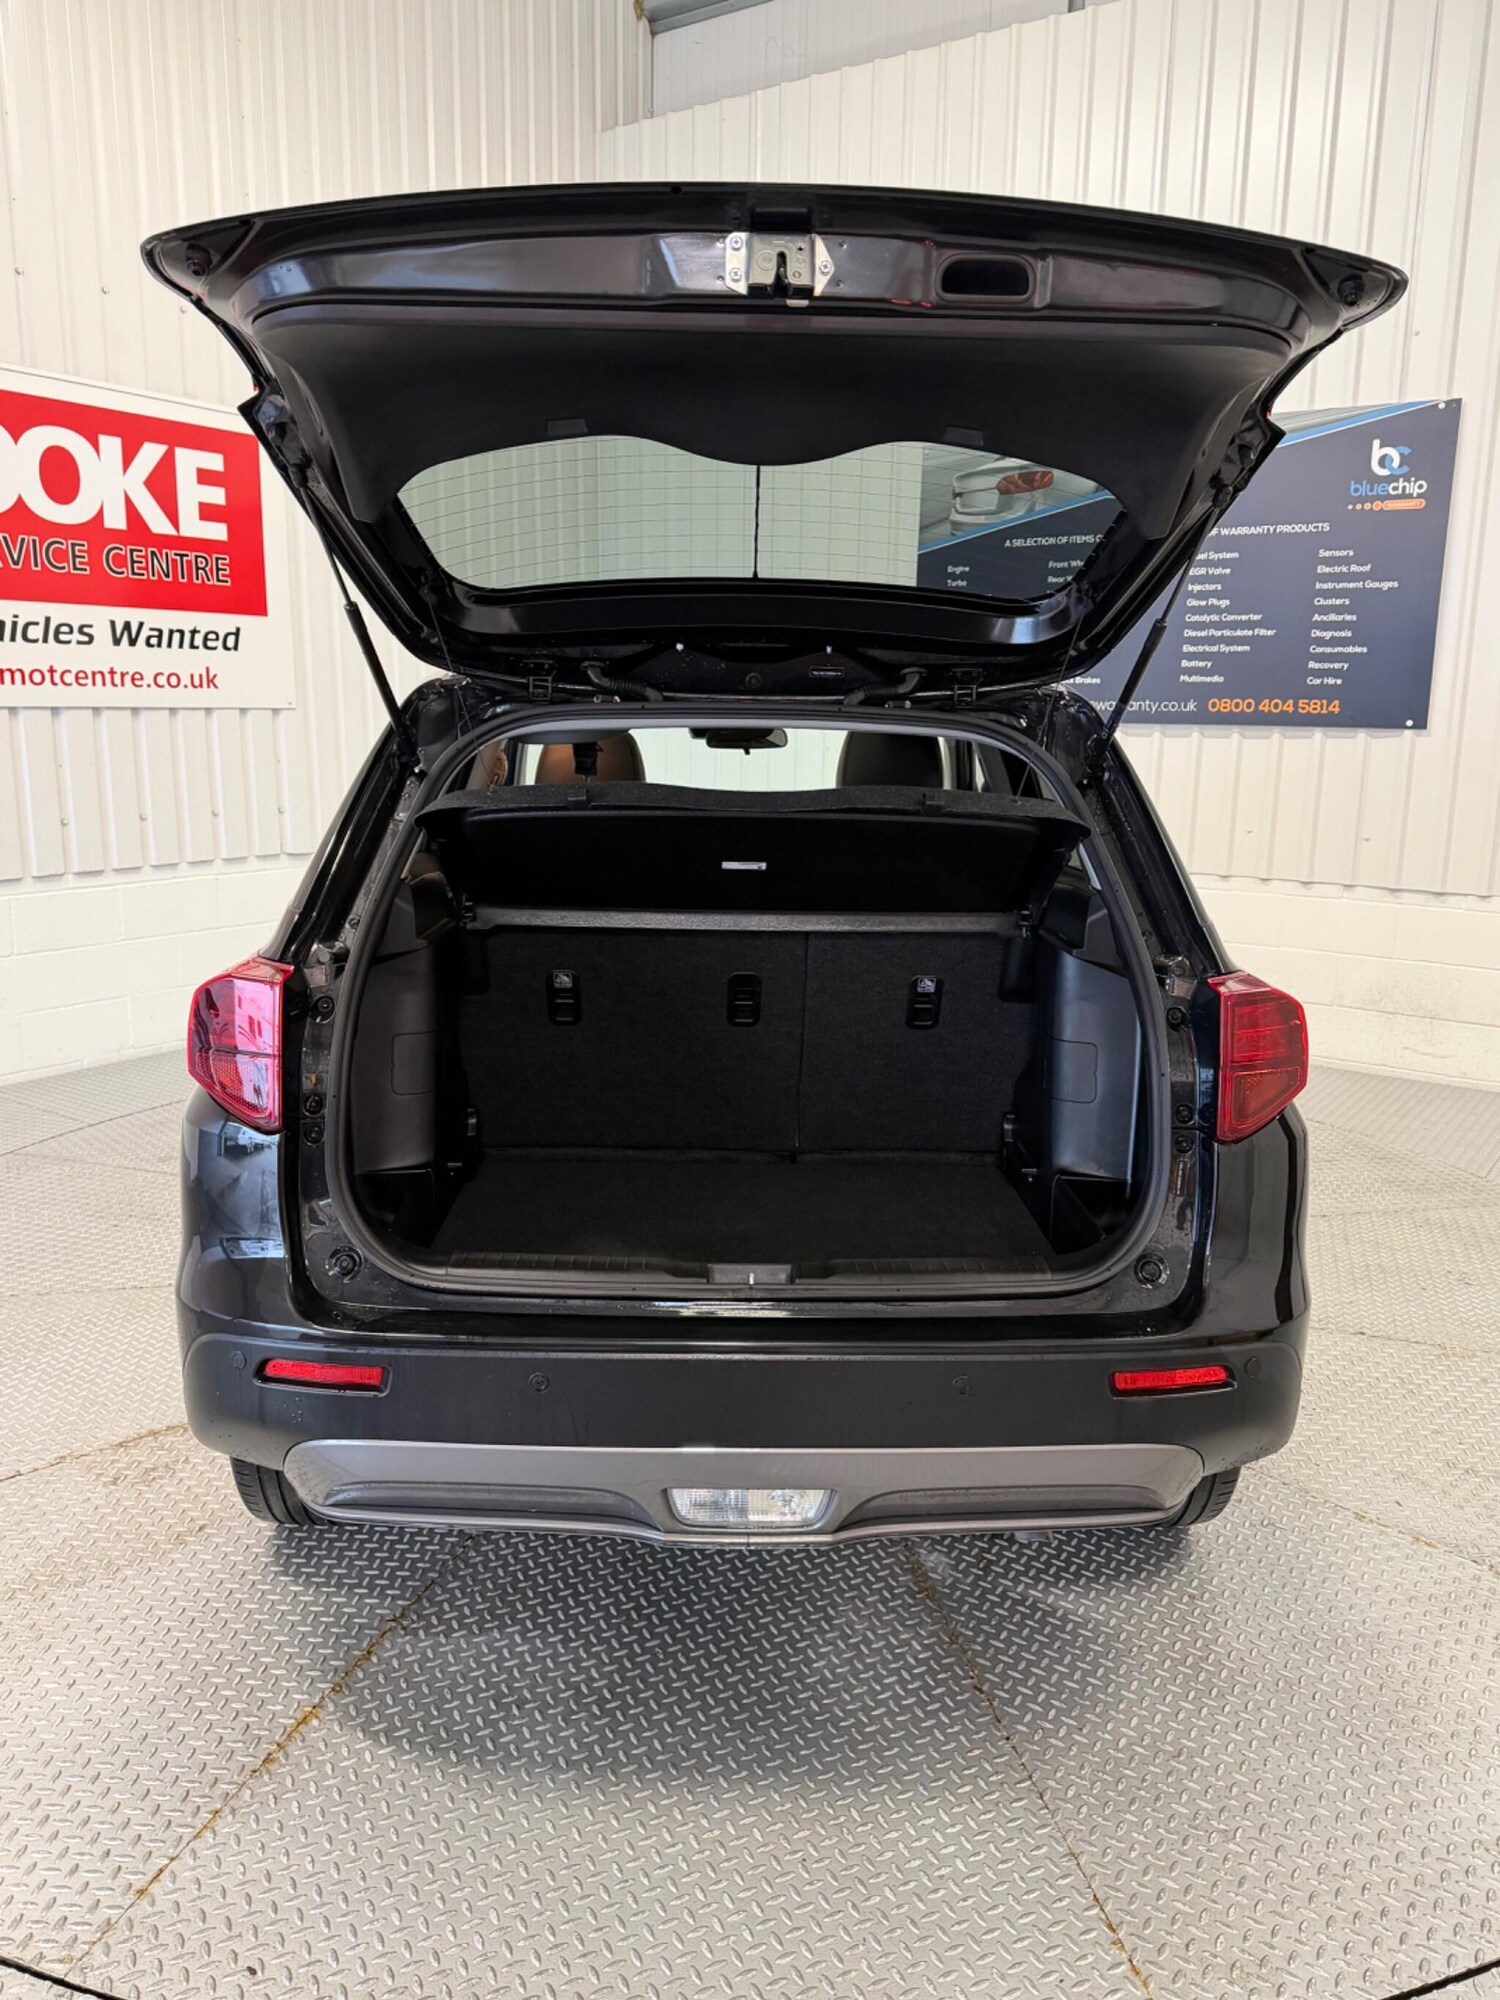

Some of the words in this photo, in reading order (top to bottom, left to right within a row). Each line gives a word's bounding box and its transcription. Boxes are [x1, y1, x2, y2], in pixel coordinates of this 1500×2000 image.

[0, 425, 228, 541] OKE
[1349, 477, 1428, 497] bluechip
[1220, 525, 1276, 536] WARRANTY
[1276, 522, 1330, 534] PRODUCTS
[1004, 539, 1012, 548] A
[1012, 536, 1057, 548] SELECTION
[1057, 535, 1069, 545] OF
[1069, 534, 1095, 544] ITEMS
[1208, 551, 1240, 561] System
[1318, 548, 1354, 557] Sensors
[0, 533, 90, 574] VICE
[102, 544, 231, 587] CENTRE
[1048, 560, 1068, 569] Front
[947, 565, 970, 575] Engine
[1189, 566, 1207, 576] EGR
[1207, 566, 1232, 576] Valve
[1317, 564, 1349, 574] Electric
[1349, 563, 1372, 573] Roof
[947, 579, 968, 588] Turbo
[1188, 582, 1222, 594] Injectors
[1315, 581, 1364, 590] Instrument
[1364, 579, 1399, 591] Gauges
[1186, 598, 1207, 607] Glow
[1208, 598, 1231, 609] Plugs
[1314, 596, 1350, 606] Clusters
[1185, 613, 1221, 624] Catalytic
[1221, 612, 1264, 622] Converter
[1312, 613, 1358, 622] Ancillaries
[108, 619, 242, 653] Wanted
[1183, 628, 1208, 638] Diesel
[1208, 628, 1254, 638] Particulate
[1254, 627, 1278, 637] Filter
[1311, 628, 1353, 640] Diagnosis
[1182, 643, 1219, 653] Electrical
[1219, 643, 1252, 654] System
[1309, 644, 1369, 654] Consumables
[1181, 659, 1213, 670] Battery
[1308, 660, 1350, 671] Recovery
[0, 664, 220, 691] motcentre.co.uk
[1179, 674, 1225, 684] Multimedia
[1306, 676, 1322, 686] Car
[1323, 676, 1343, 686] Hire
[1207, 698, 1256, 713] 0800
[1258, 698, 1295, 713] 404
[1297, 698, 1341, 715] 5814
